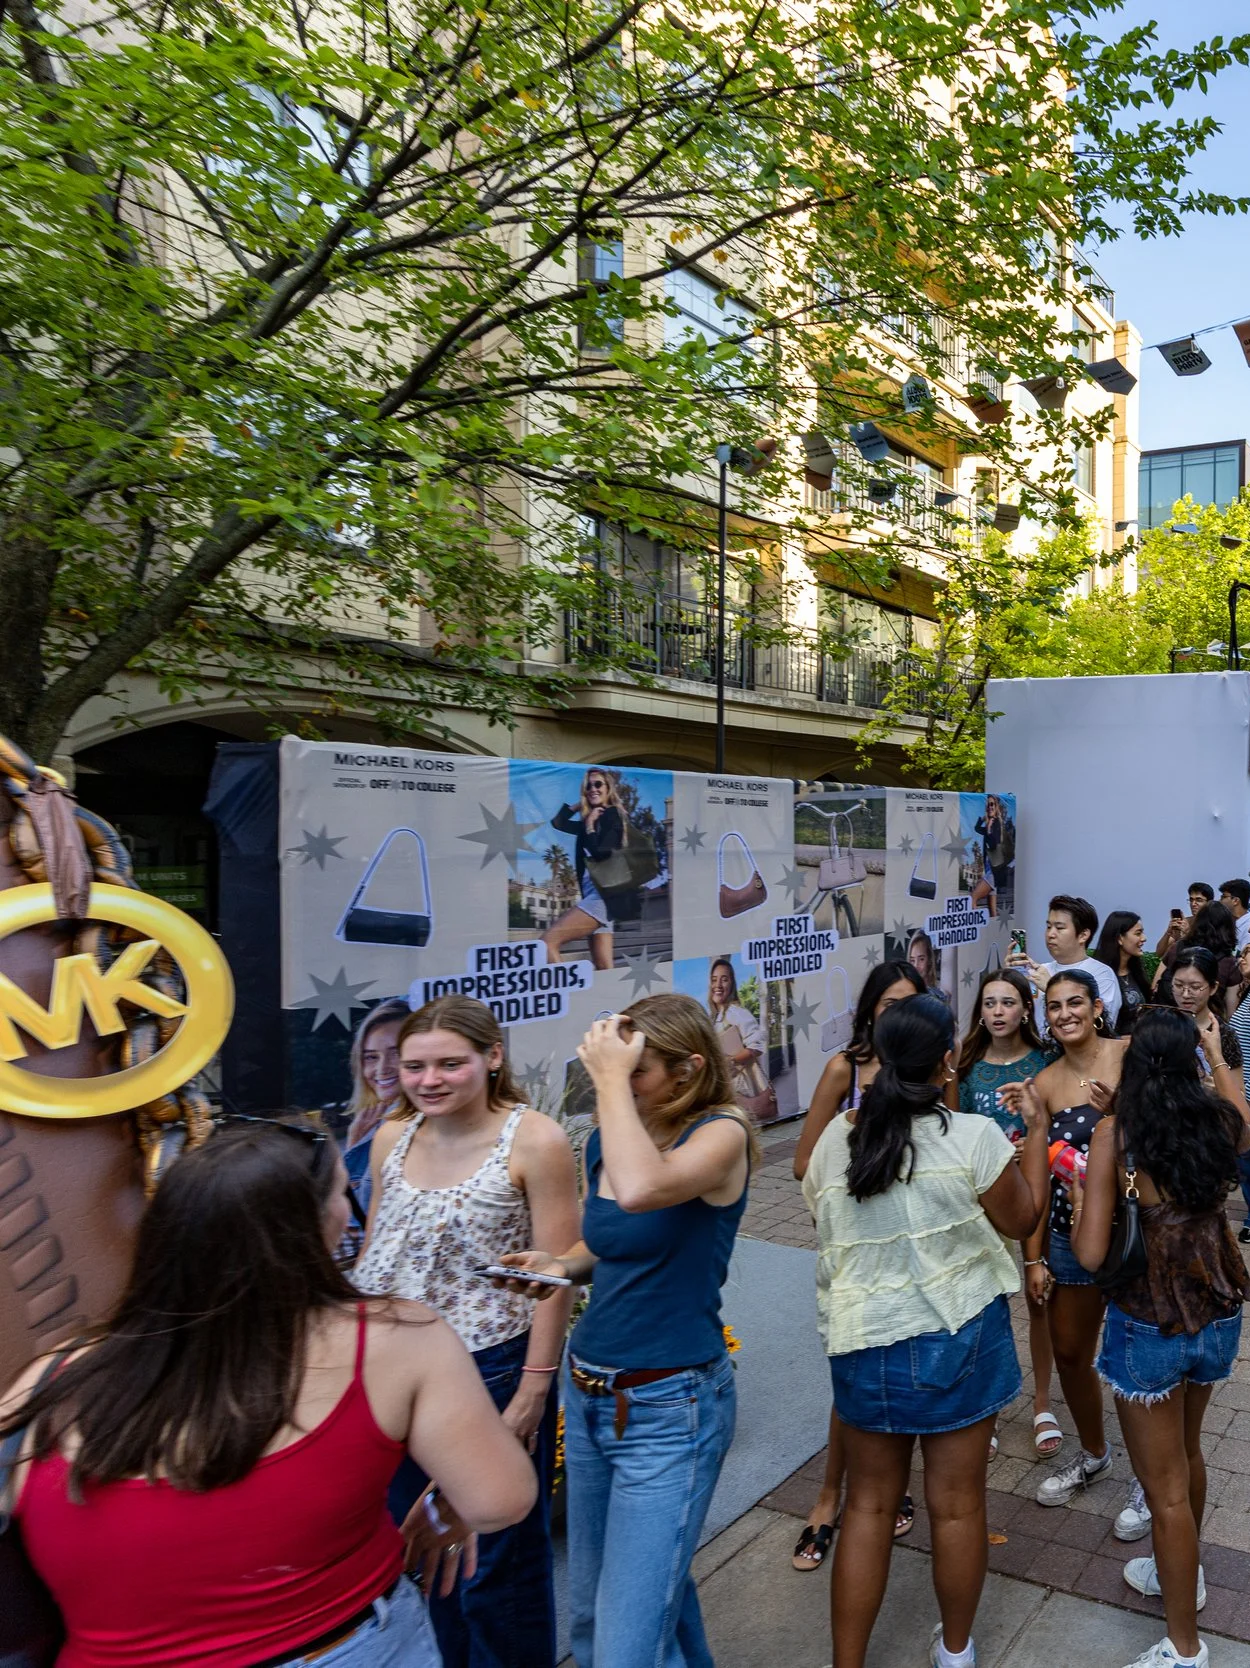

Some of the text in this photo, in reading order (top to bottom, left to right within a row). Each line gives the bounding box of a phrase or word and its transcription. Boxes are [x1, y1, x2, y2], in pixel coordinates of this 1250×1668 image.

[1176, 358, 1204, 372] PARTY
[333, 753, 455, 772] MICHAEL KORS
[370, 779, 456, 793] OFF TO COLLEGE
[707, 779, 769, 792] MICHAEL KORS
[905, 792, 929, 800] MICHAEL
[947, 897, 969, 913] FIRST
[776, 916, 809, 936] FIRST
[929, 910, 986, 932] IMPRESSIONS,
[748, 932, 835, 960] IMPRESSIONS,
[938, 927, 977, 946] HANDLED
[475, 943, 537, 972] FIRST
[763, 953, 822, 978] HANDLED
[423, 964, 585, 1001] IMPRESSIONS,
[490, 992, 562, 1024] NDLED
